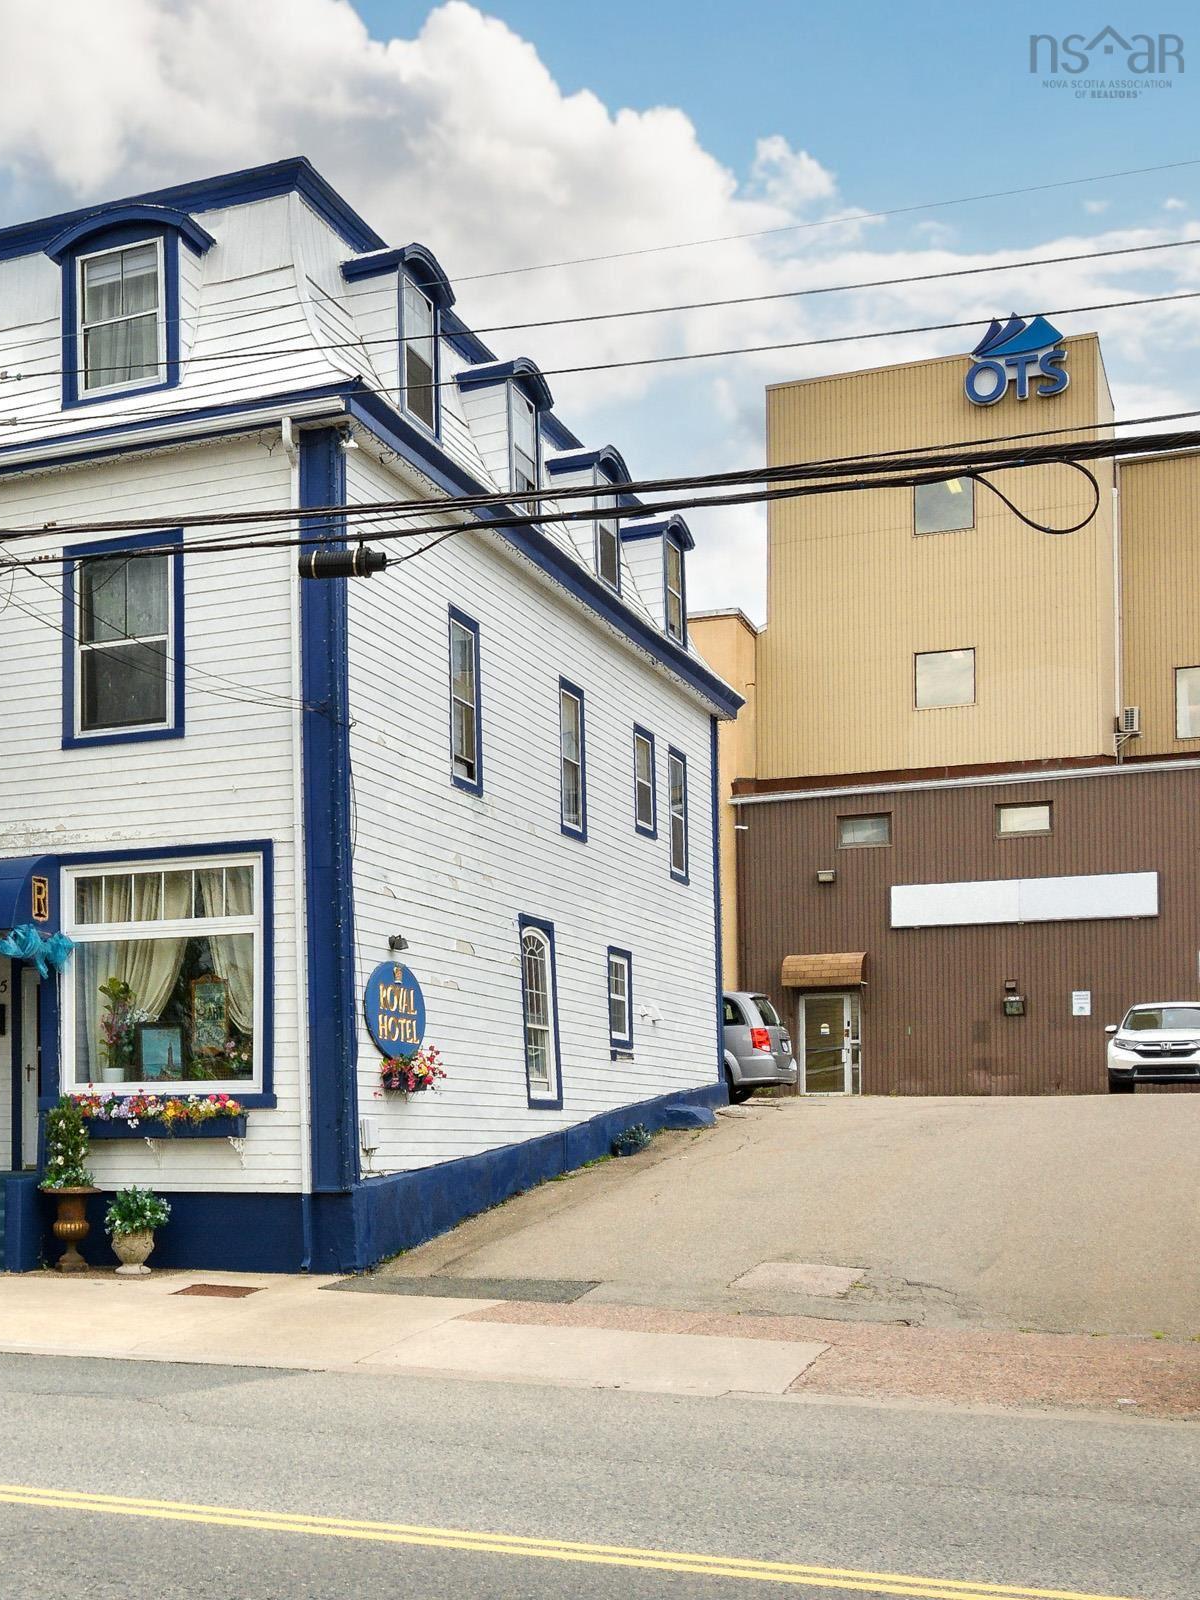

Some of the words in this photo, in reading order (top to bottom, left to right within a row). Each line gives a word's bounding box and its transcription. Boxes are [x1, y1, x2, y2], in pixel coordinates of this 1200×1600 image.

[965, 350, 1070, 406] OTS
[379, 984, 417, 1015] ROYAL
[378, 1013, 420, 1045] HOTEL
